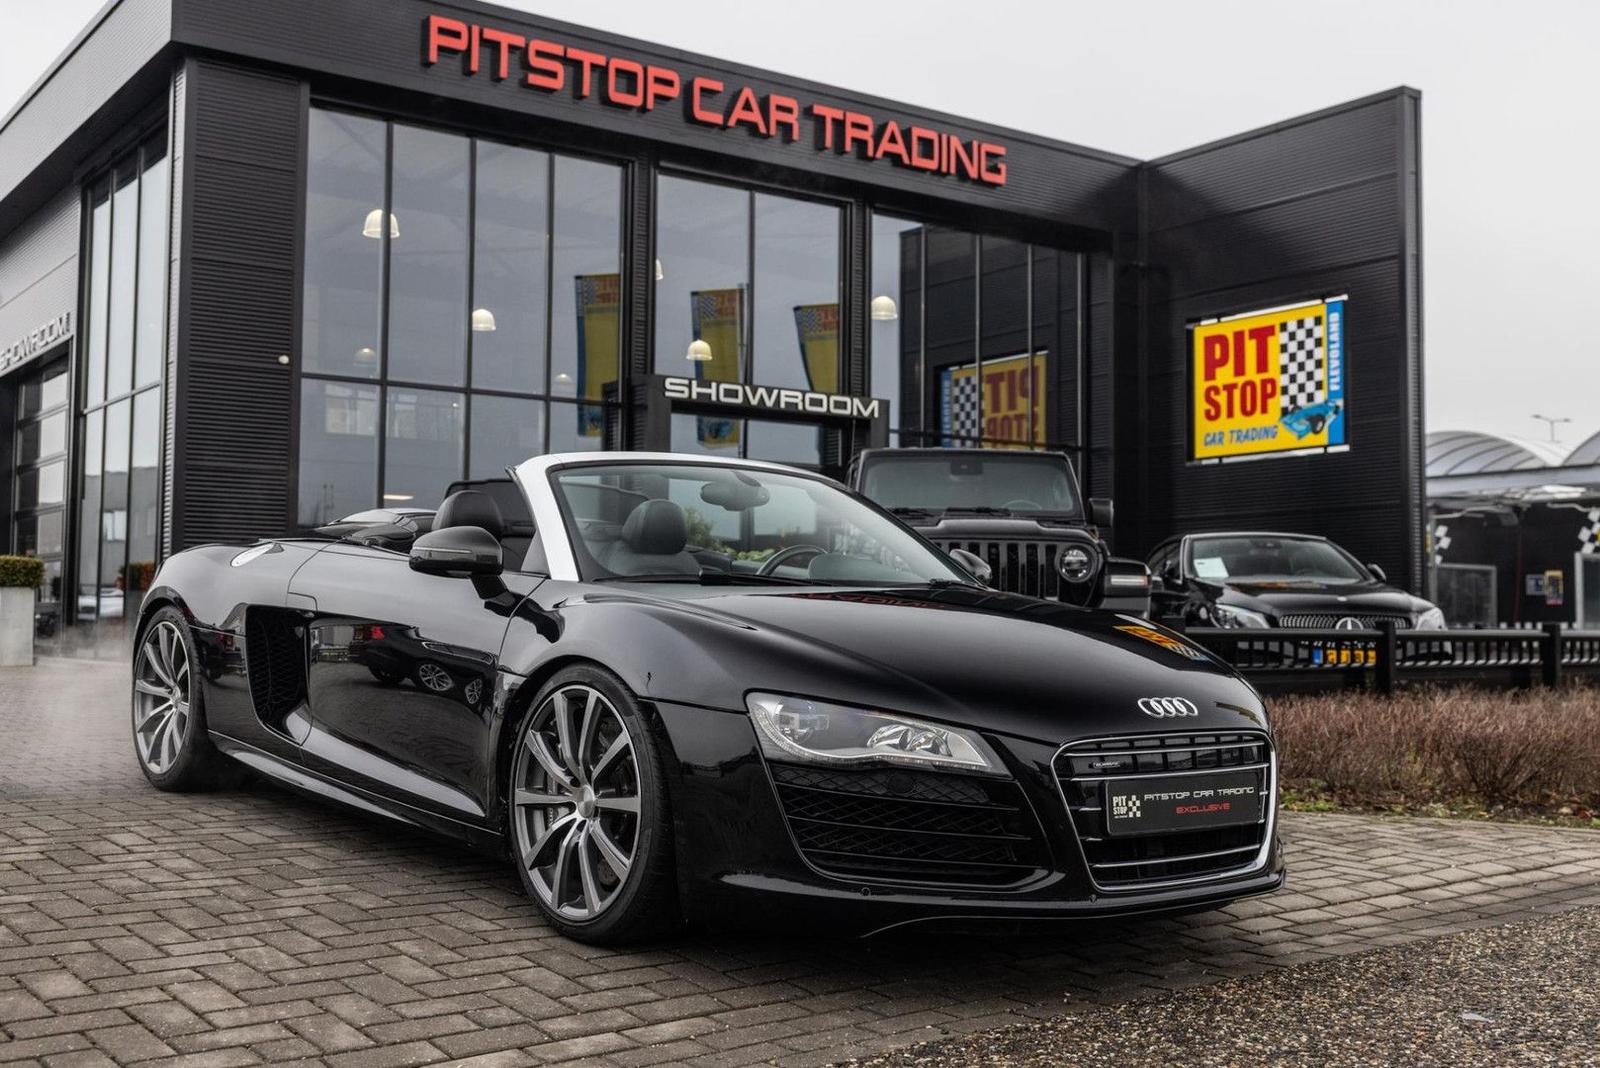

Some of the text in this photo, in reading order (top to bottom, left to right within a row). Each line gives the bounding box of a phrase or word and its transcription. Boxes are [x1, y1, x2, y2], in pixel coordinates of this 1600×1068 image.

[428, 15, 1007, 185] PITSTOP CAR TRADING
[1203, 324, 1276, 382] PIT
[664, 377, 879, 419] SHOWROOM
[1203, 377, 1278, 422] STOP
[1203, 424, 1278, 447] CAR TRADING
[1112, 795, 1127, 806] PIT
[1144, 786, 1255, 801] PITSTOP CAR TRADING
[1112, 806, 1128, 815] STOP
[1176, 802, 1231, 814] EXCLUSIVE
